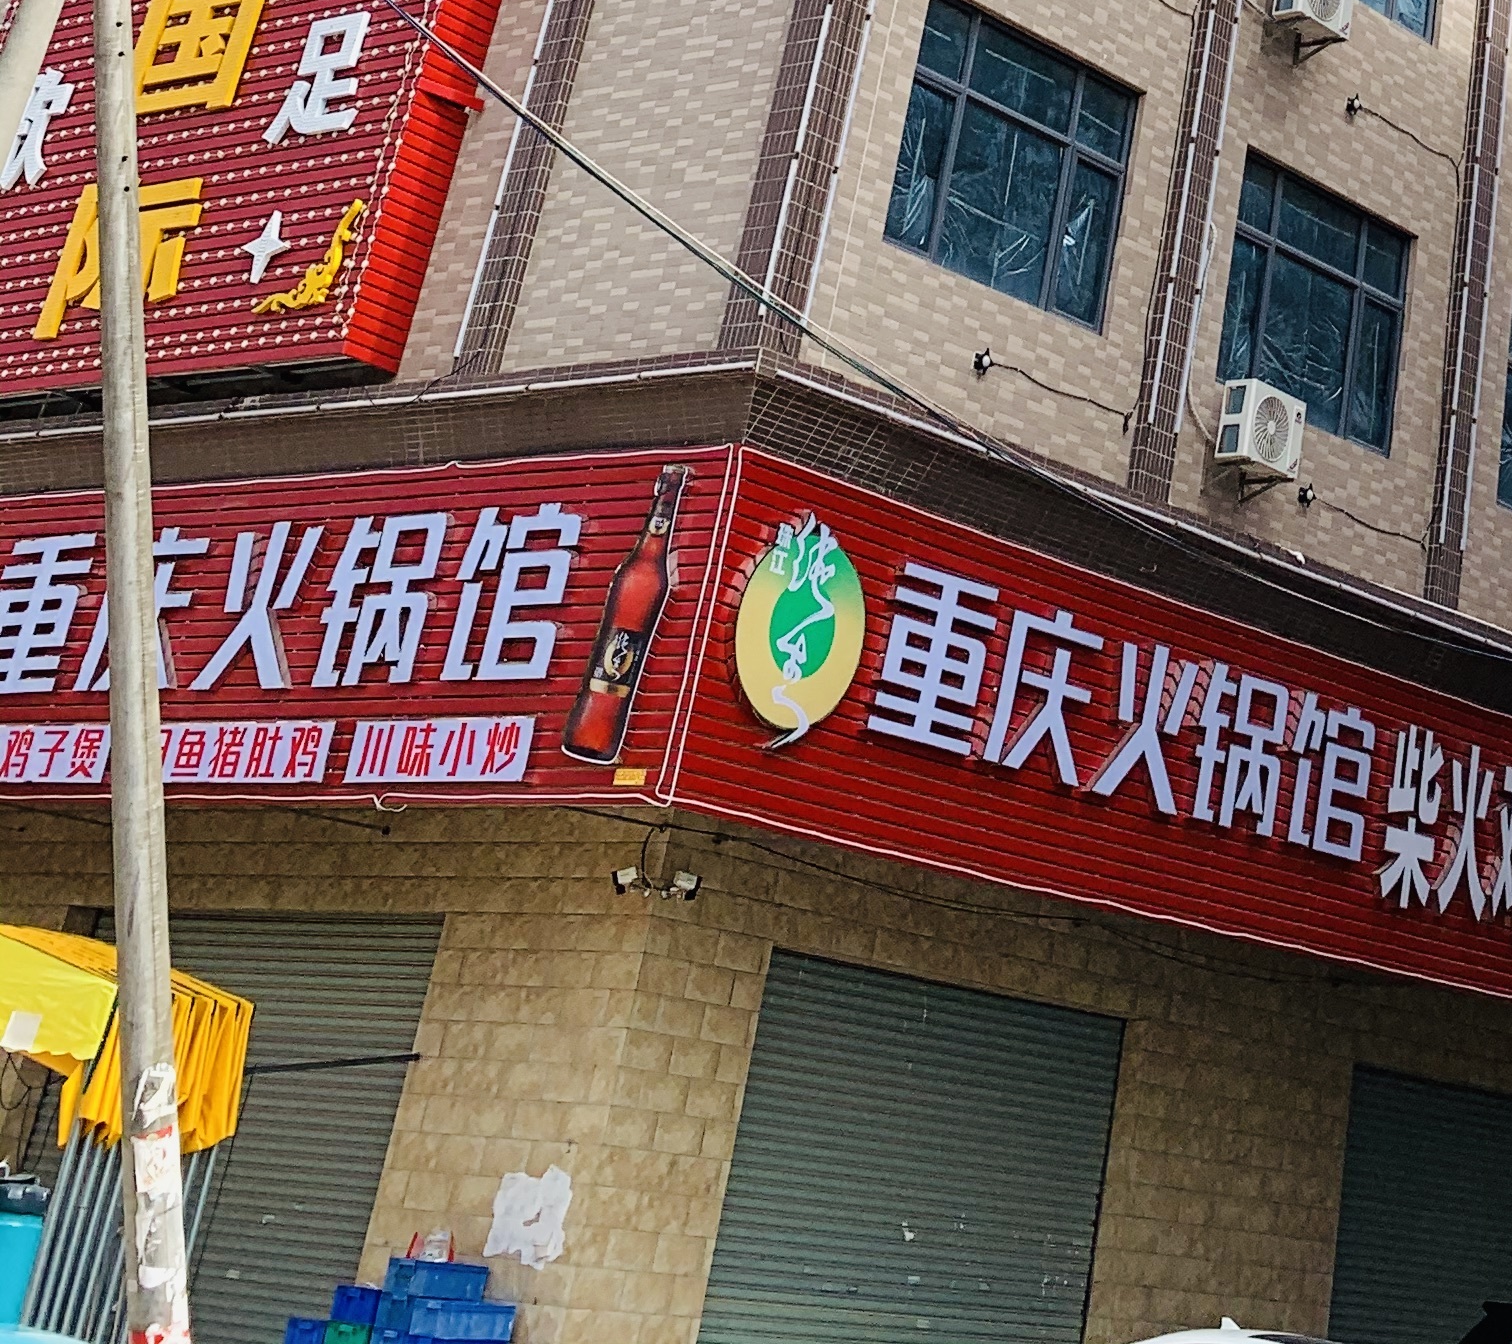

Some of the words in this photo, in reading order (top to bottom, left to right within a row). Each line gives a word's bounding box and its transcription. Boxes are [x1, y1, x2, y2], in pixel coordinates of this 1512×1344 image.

[0, 502, 583, 694] 重庆火锅馆
[356, 723, 524, 778] 川味小炒
[866, 562, 1376, 862] 重庆火锅馆
